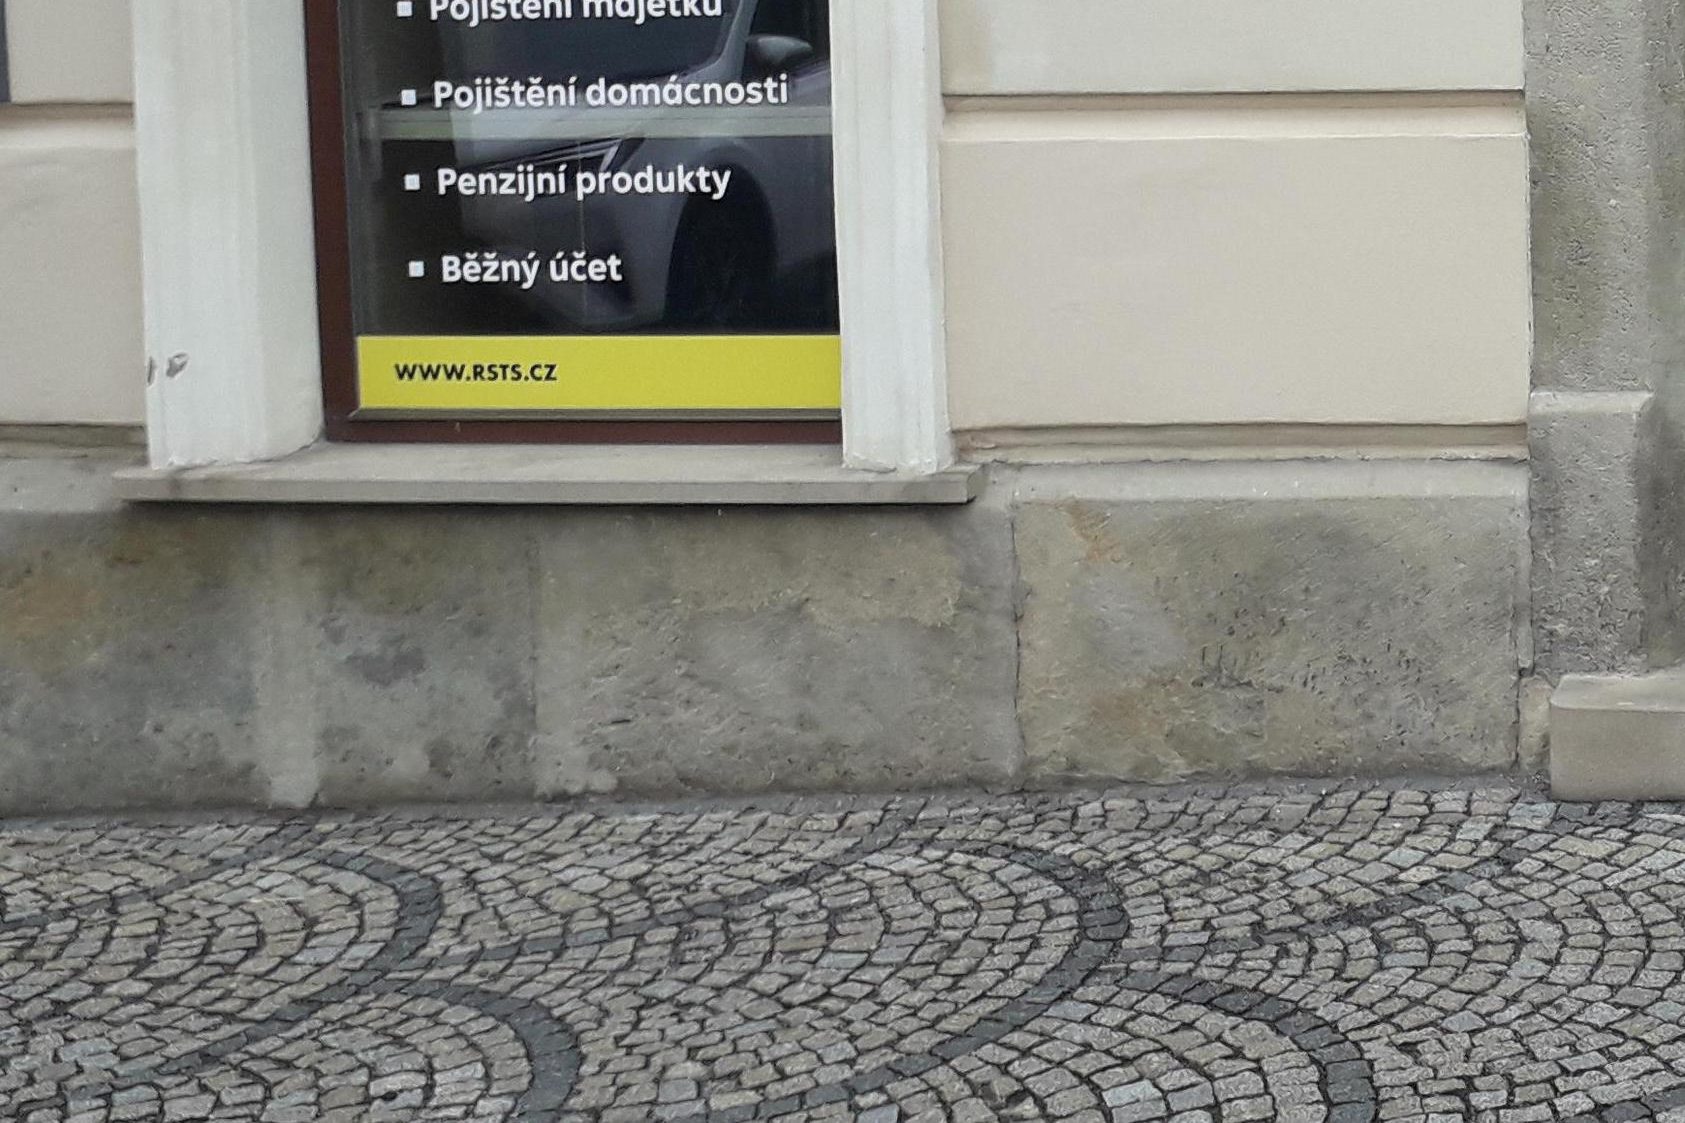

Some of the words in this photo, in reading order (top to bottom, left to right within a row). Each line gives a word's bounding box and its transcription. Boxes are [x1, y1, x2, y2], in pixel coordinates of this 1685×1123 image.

[434, 76, 578, 115] Pojištění
[585, 73, 789, 107] domácnosti
[437, 164, 567, 203] Penzijní
[575, 164, 732, 202] produkty
[441, 251, 540, 290] Běžný
[549, 250, 622, 283] účet
[394, 362, 558, 383] WWW.RSTS.CZ
